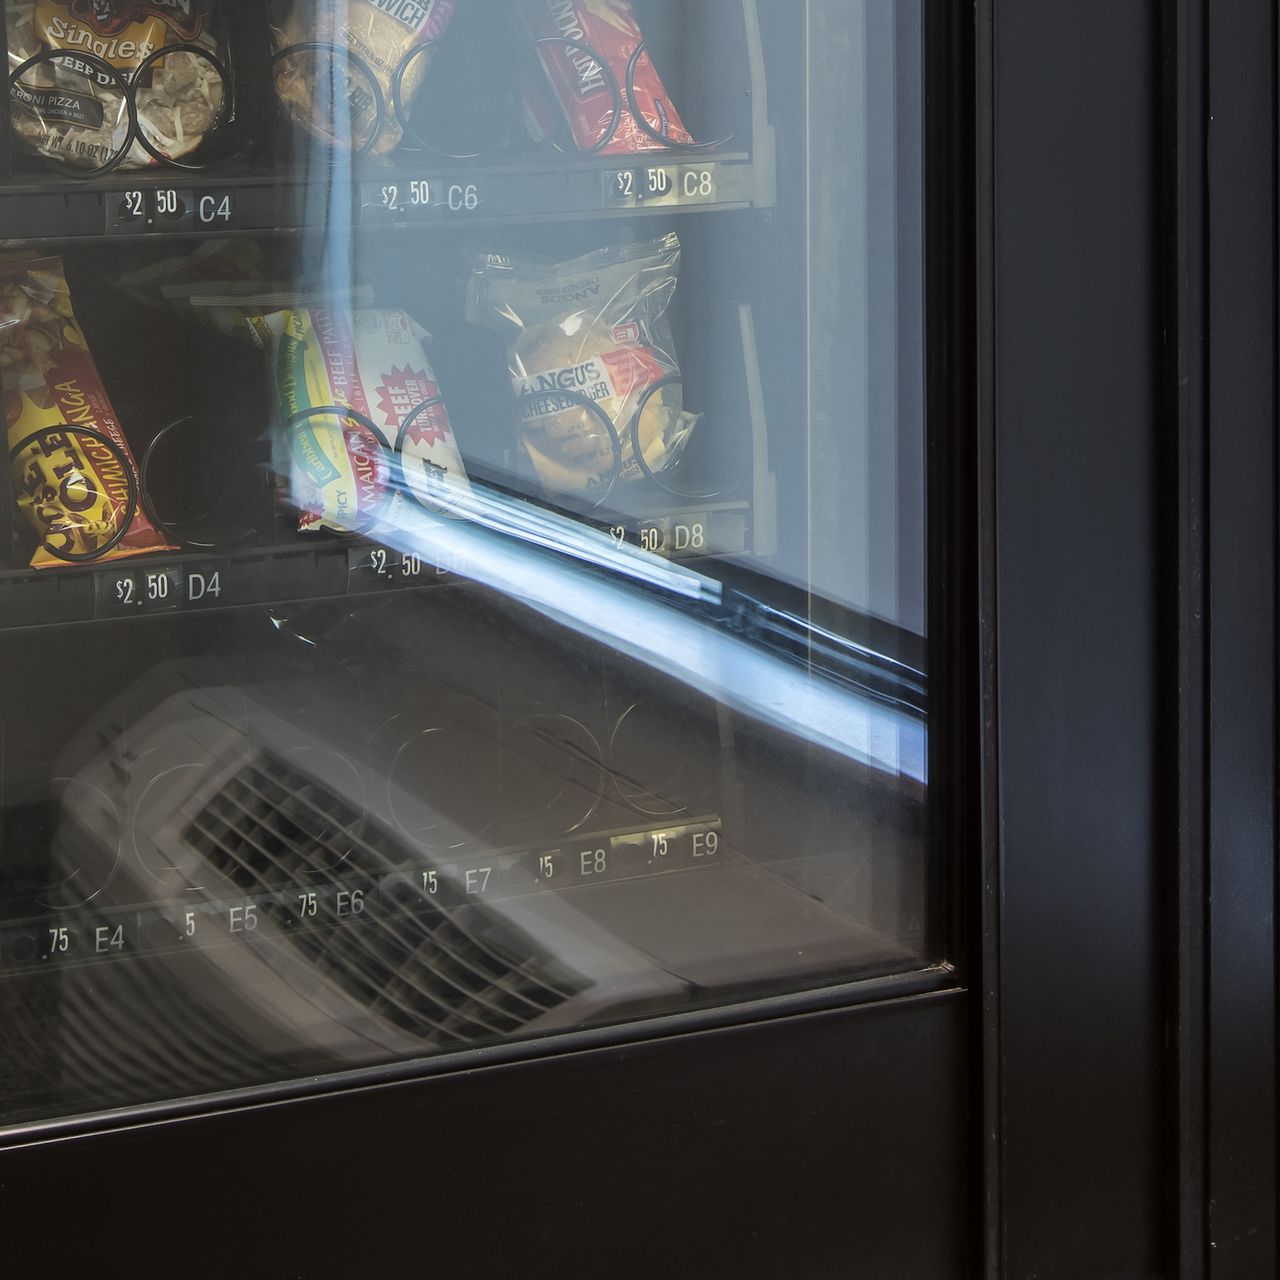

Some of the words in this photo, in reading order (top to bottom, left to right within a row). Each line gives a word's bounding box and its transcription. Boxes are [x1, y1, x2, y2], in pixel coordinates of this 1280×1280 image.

[47, 17, 154, 60] Singles
[48, 96, 81, 111] PIZZA
[521, 362, 600, 394] ANGUS
[116, 572, 168, 606] $2.50
[188, 572, 221, 600] D4
